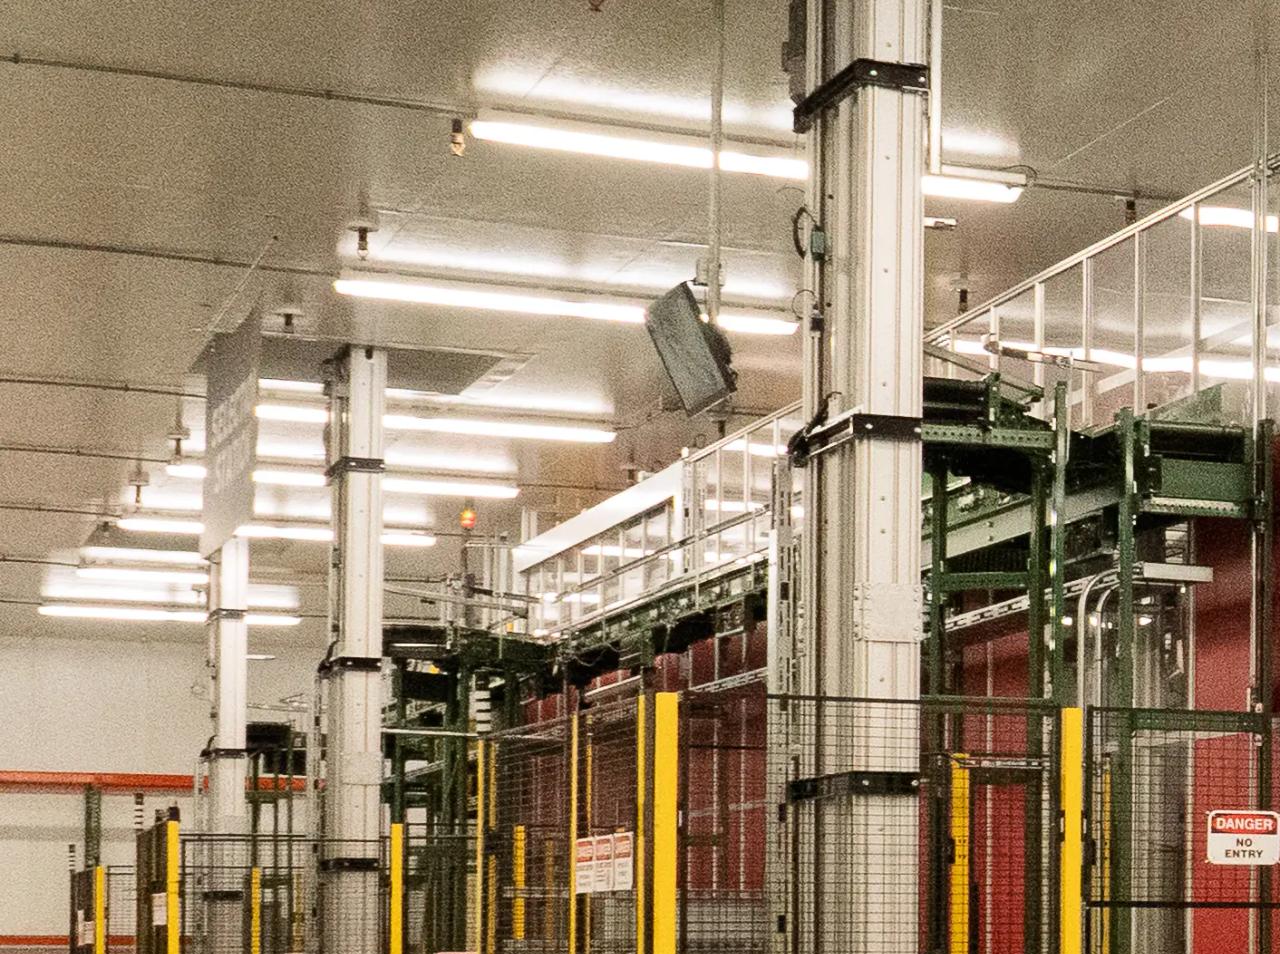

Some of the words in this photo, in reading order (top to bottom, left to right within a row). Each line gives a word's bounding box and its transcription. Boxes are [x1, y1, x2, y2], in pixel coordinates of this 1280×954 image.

[1215, 817, 1274, 831] DANGER
[1236, 838, 1253, 847] NO
[1225, 849, 1263, 858] ENTRY
